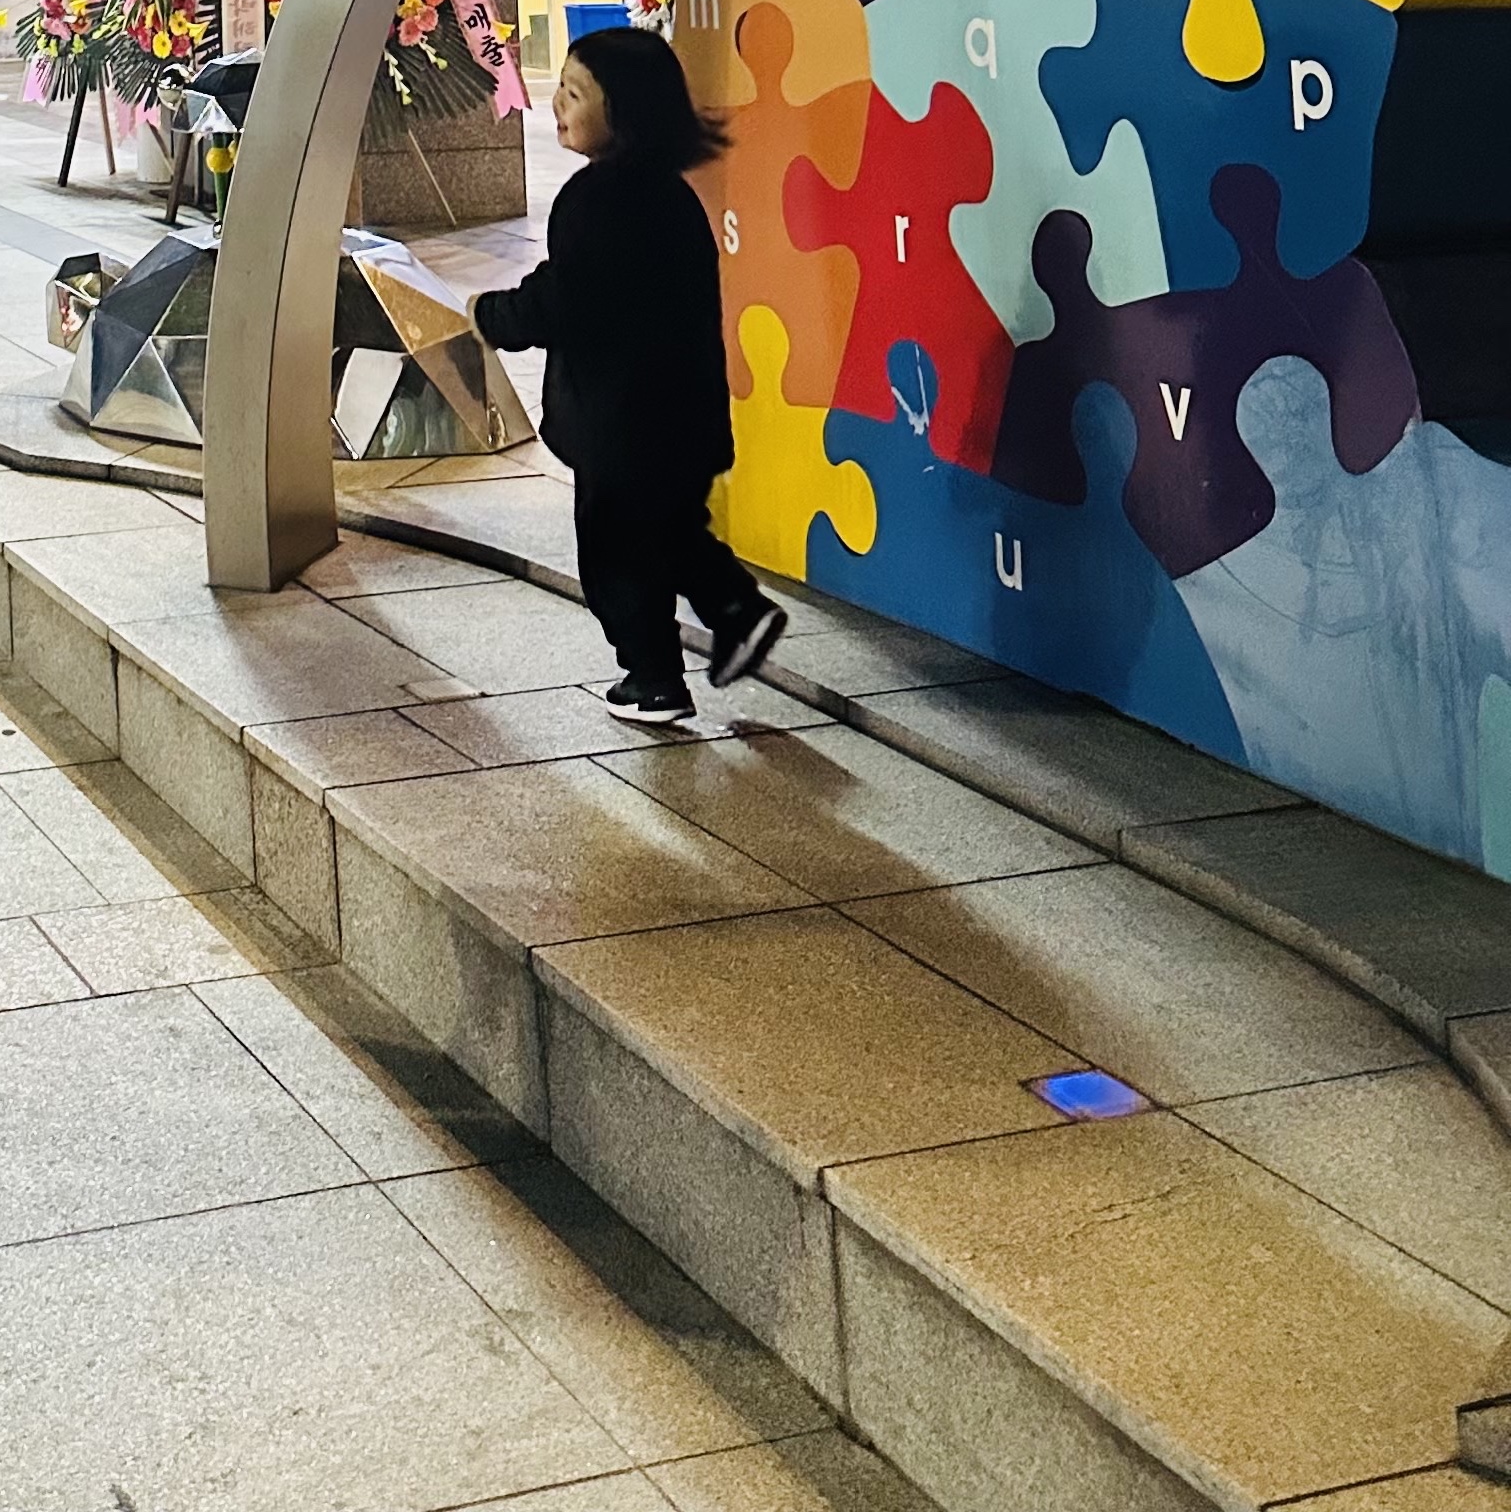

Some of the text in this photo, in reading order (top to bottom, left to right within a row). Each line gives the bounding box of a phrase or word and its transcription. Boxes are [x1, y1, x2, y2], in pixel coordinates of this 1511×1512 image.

[464, 3, 505, 66] 매출
[964, 16, 997, 79] q
[1290, 57, 1335, 131] p
[724, 209, 740, 255] s
[895, 214, 909, 262] r
[1159, 382, 1191, 441] v
[994, 532, 1023, 592] u
